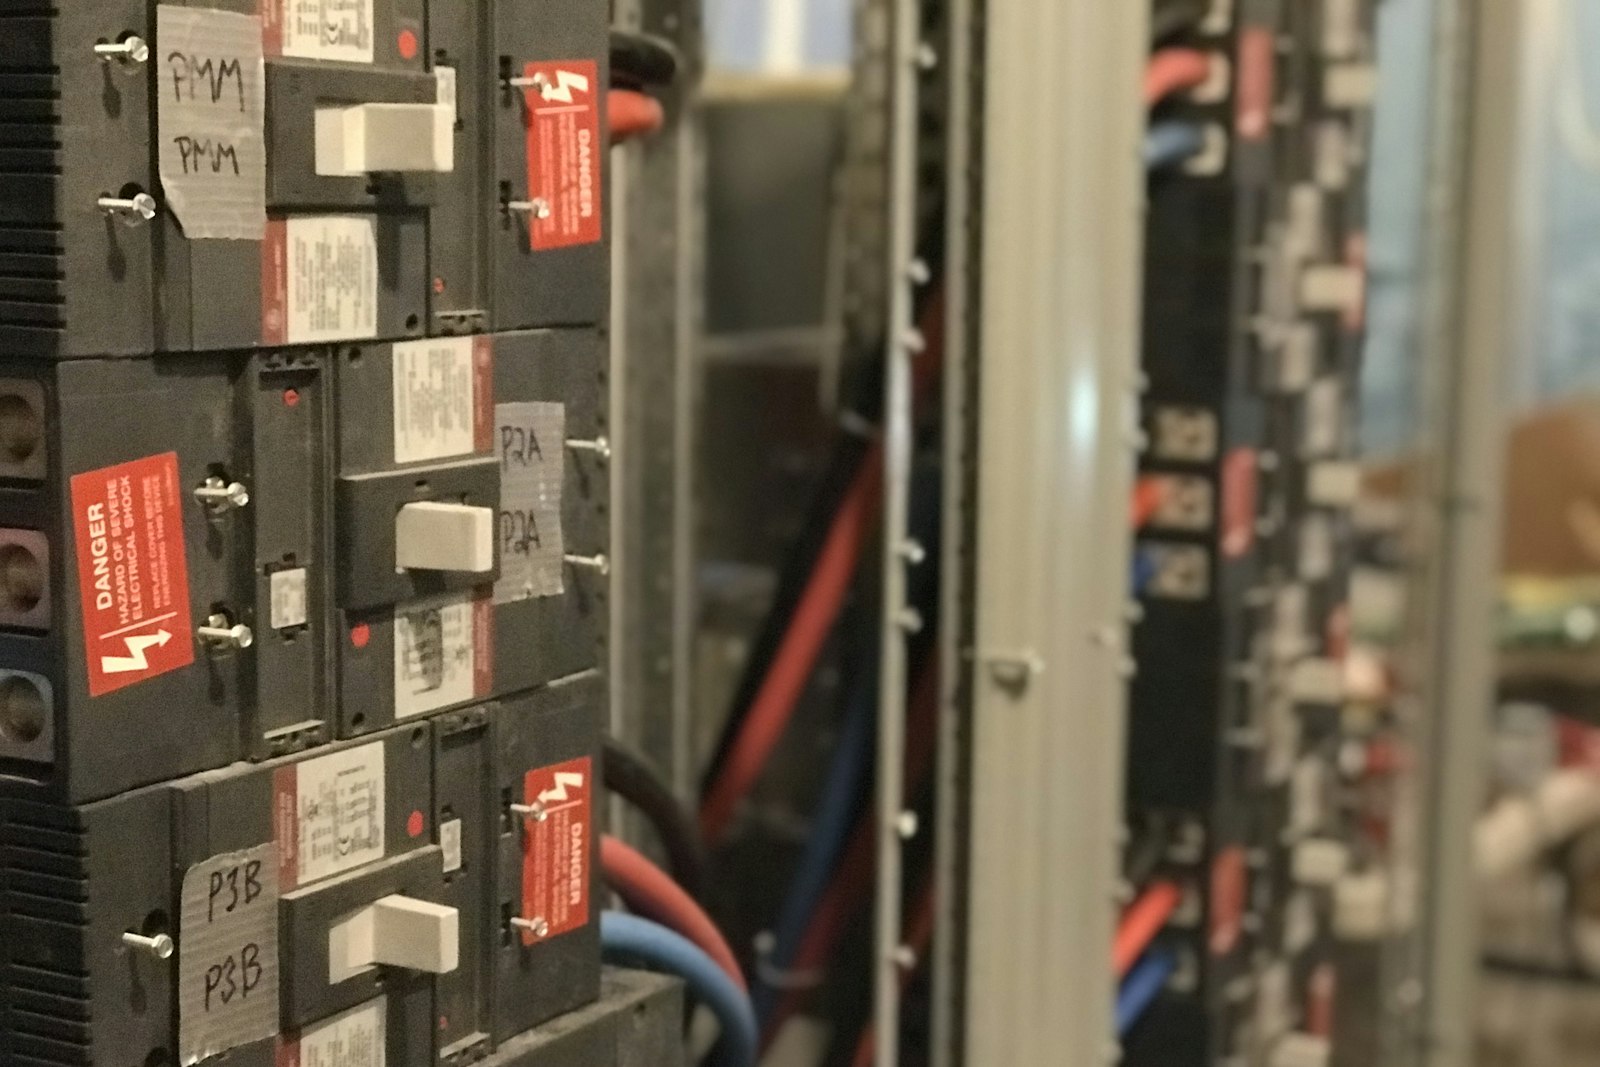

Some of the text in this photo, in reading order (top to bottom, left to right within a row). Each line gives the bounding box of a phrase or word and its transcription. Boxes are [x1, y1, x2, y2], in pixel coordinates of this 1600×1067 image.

[168, 51, 245, 113] PMM
[173, 136, 239, 175] PMM
[578, 128, 592, 217] DANGER
[500, 425, 543, 472] P2A
[88, 502, 113, 610] DANGER
[106, 478, 130, 624] HAZARD OF SEVERE
[120, 474, 143, 620] ELECTRICAL SHOCK
[208, 860, 262, 922] P3B
[570, 822, 583, 906] DANGER
[205, 943, 263, 1012] P3B
